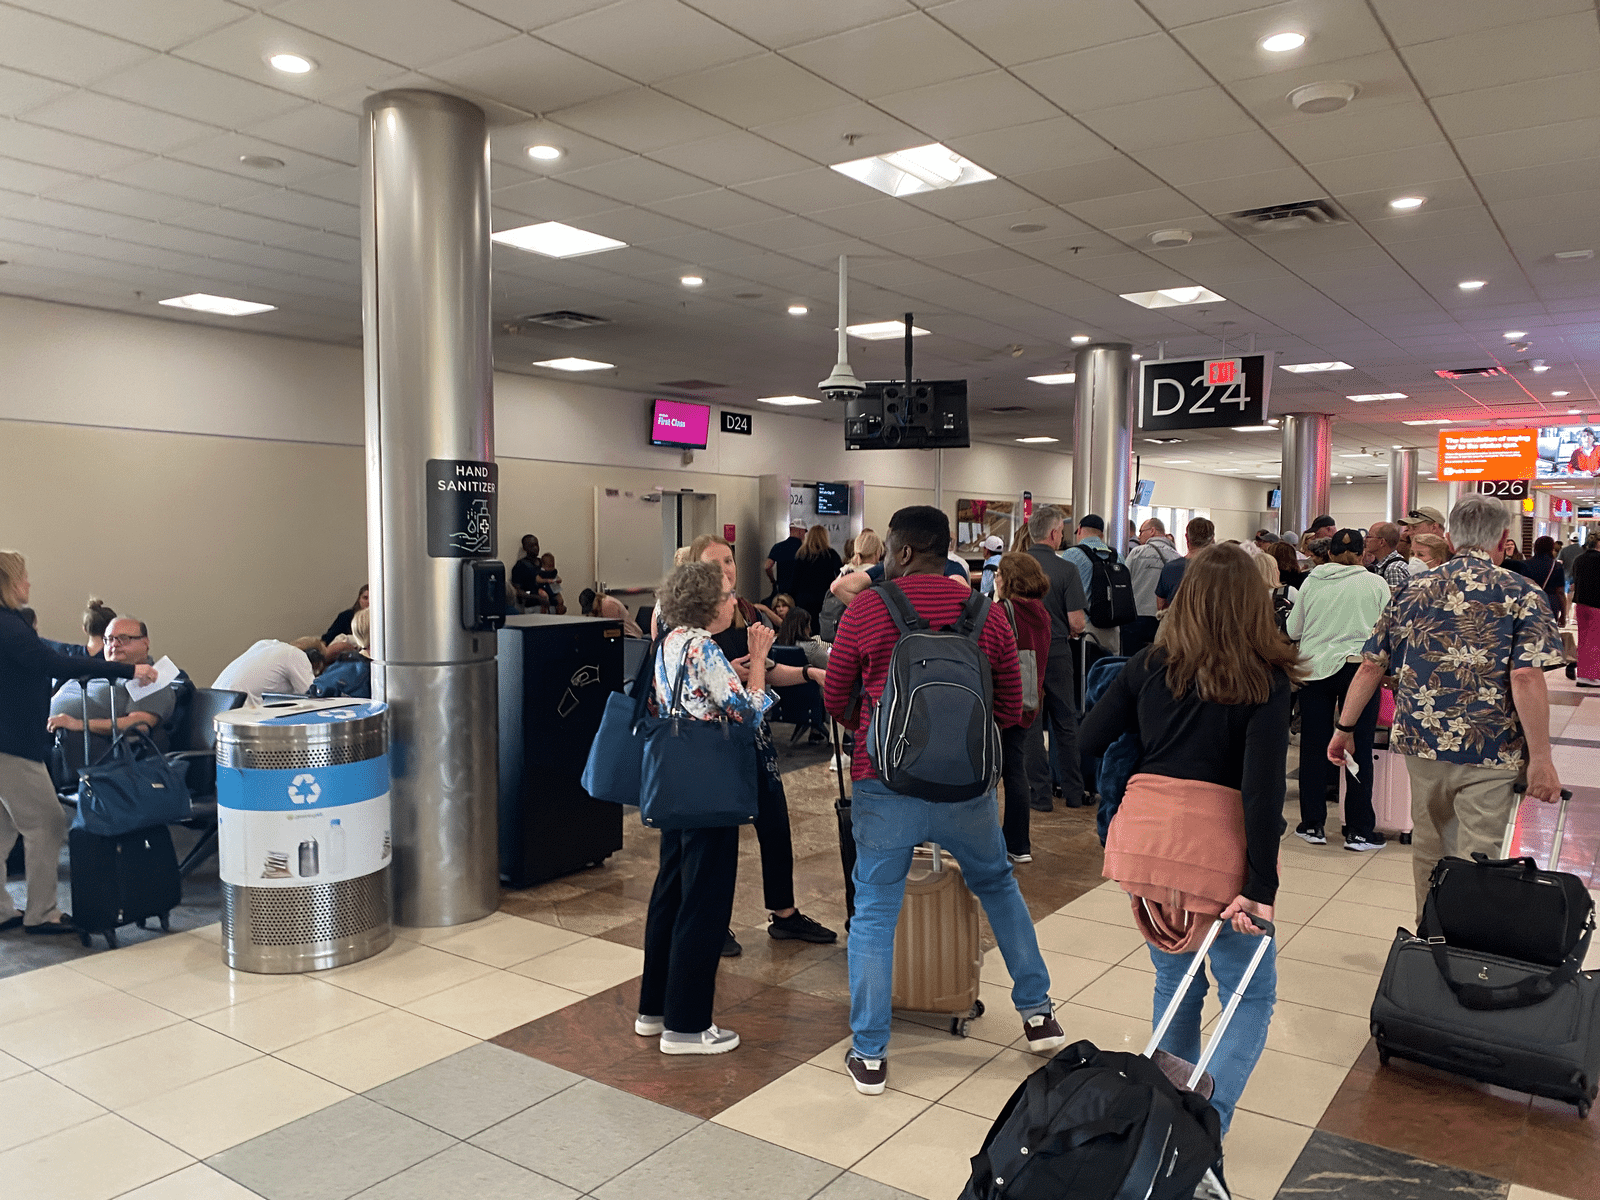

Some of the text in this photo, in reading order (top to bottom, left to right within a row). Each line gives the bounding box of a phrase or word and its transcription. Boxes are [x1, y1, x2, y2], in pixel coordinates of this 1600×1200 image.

[1209, 362, 1234, 384] EXIT
[1152, 372, 1251, 416] D24
[727, 415, 748, 431] D24
[456, 465, 489, 478] HAND
[437, 480, 496, 493] SANITIZER
[1482, 480, 1524, 496] D26
